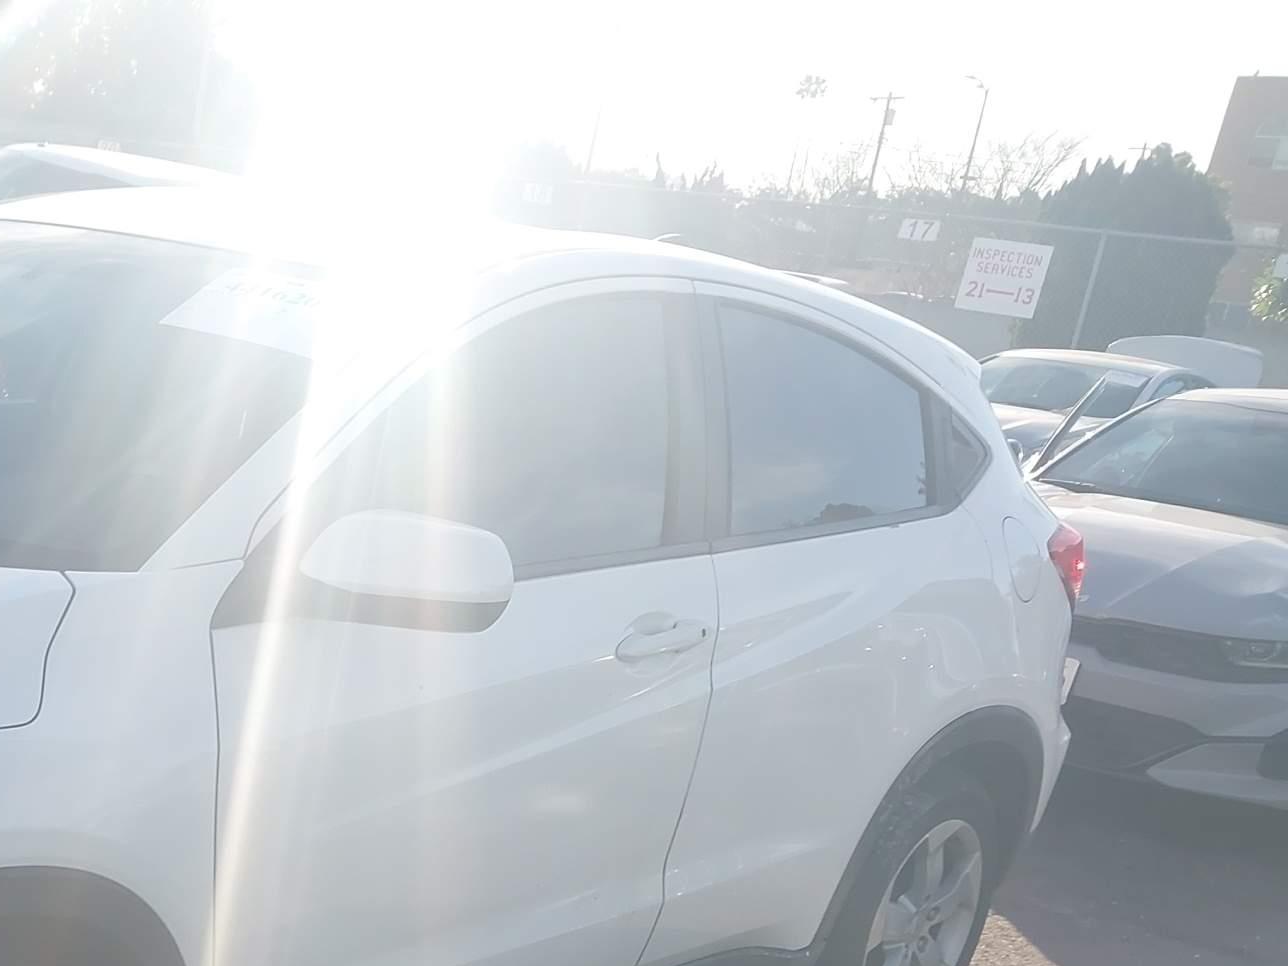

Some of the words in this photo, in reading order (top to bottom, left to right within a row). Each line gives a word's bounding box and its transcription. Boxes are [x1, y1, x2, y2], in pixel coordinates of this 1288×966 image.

[908, 220, 936, 239] 17
[972, 247, 1044, 267] INSPECTION
[976, 261, 1034, 279] SERVICES
